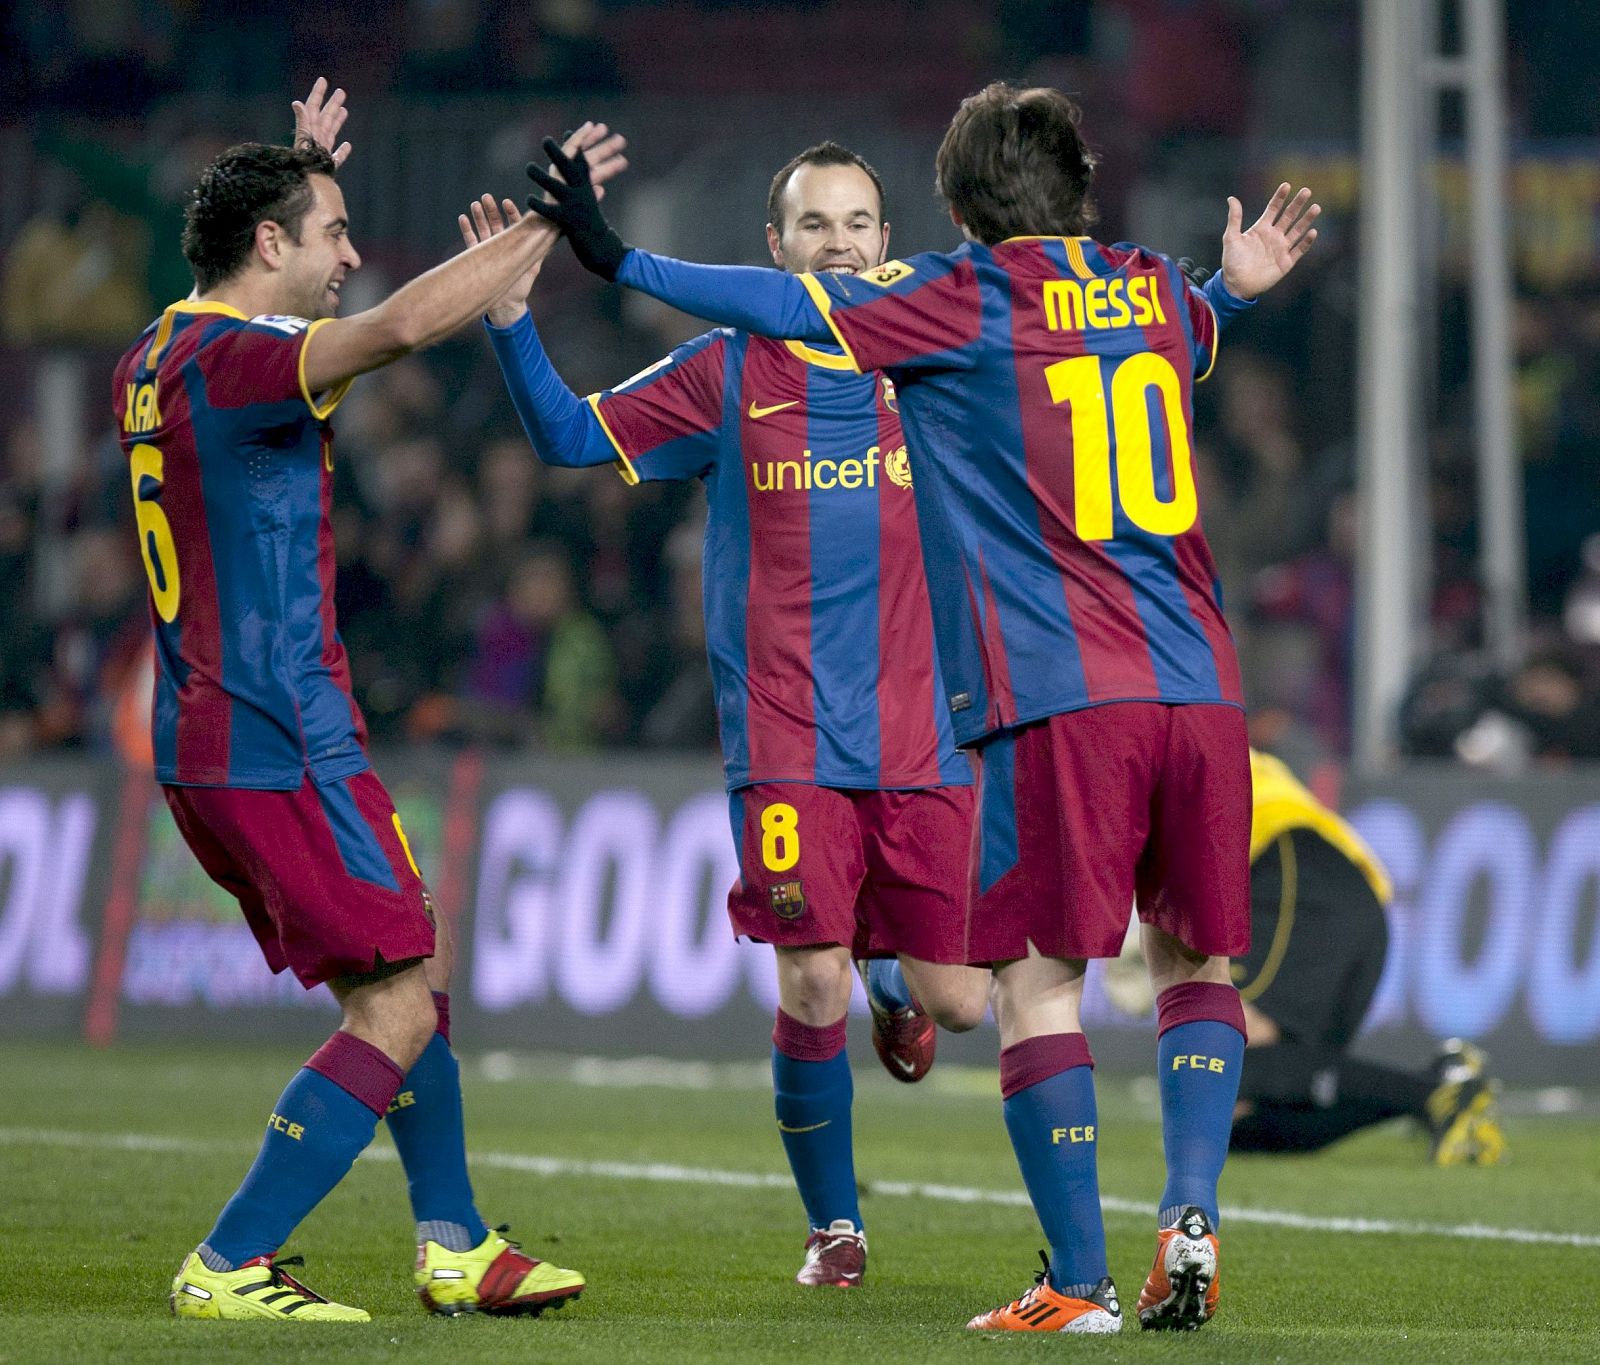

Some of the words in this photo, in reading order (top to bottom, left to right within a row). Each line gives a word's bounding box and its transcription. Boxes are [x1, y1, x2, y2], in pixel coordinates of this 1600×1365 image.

[1042, 275, 1168, 331] MESSI
[752, 446, 881, 491] unicef
[1043, 351, 1198, 541] 10
[130, 443, 181, 623] 6
[760, 802, 800, 873] 8
[1172, 1054, 1226, 1073] FCB
[267, 1112, 305, 1140] FCB
[1052, 1125, 1095, 1144] FCB
